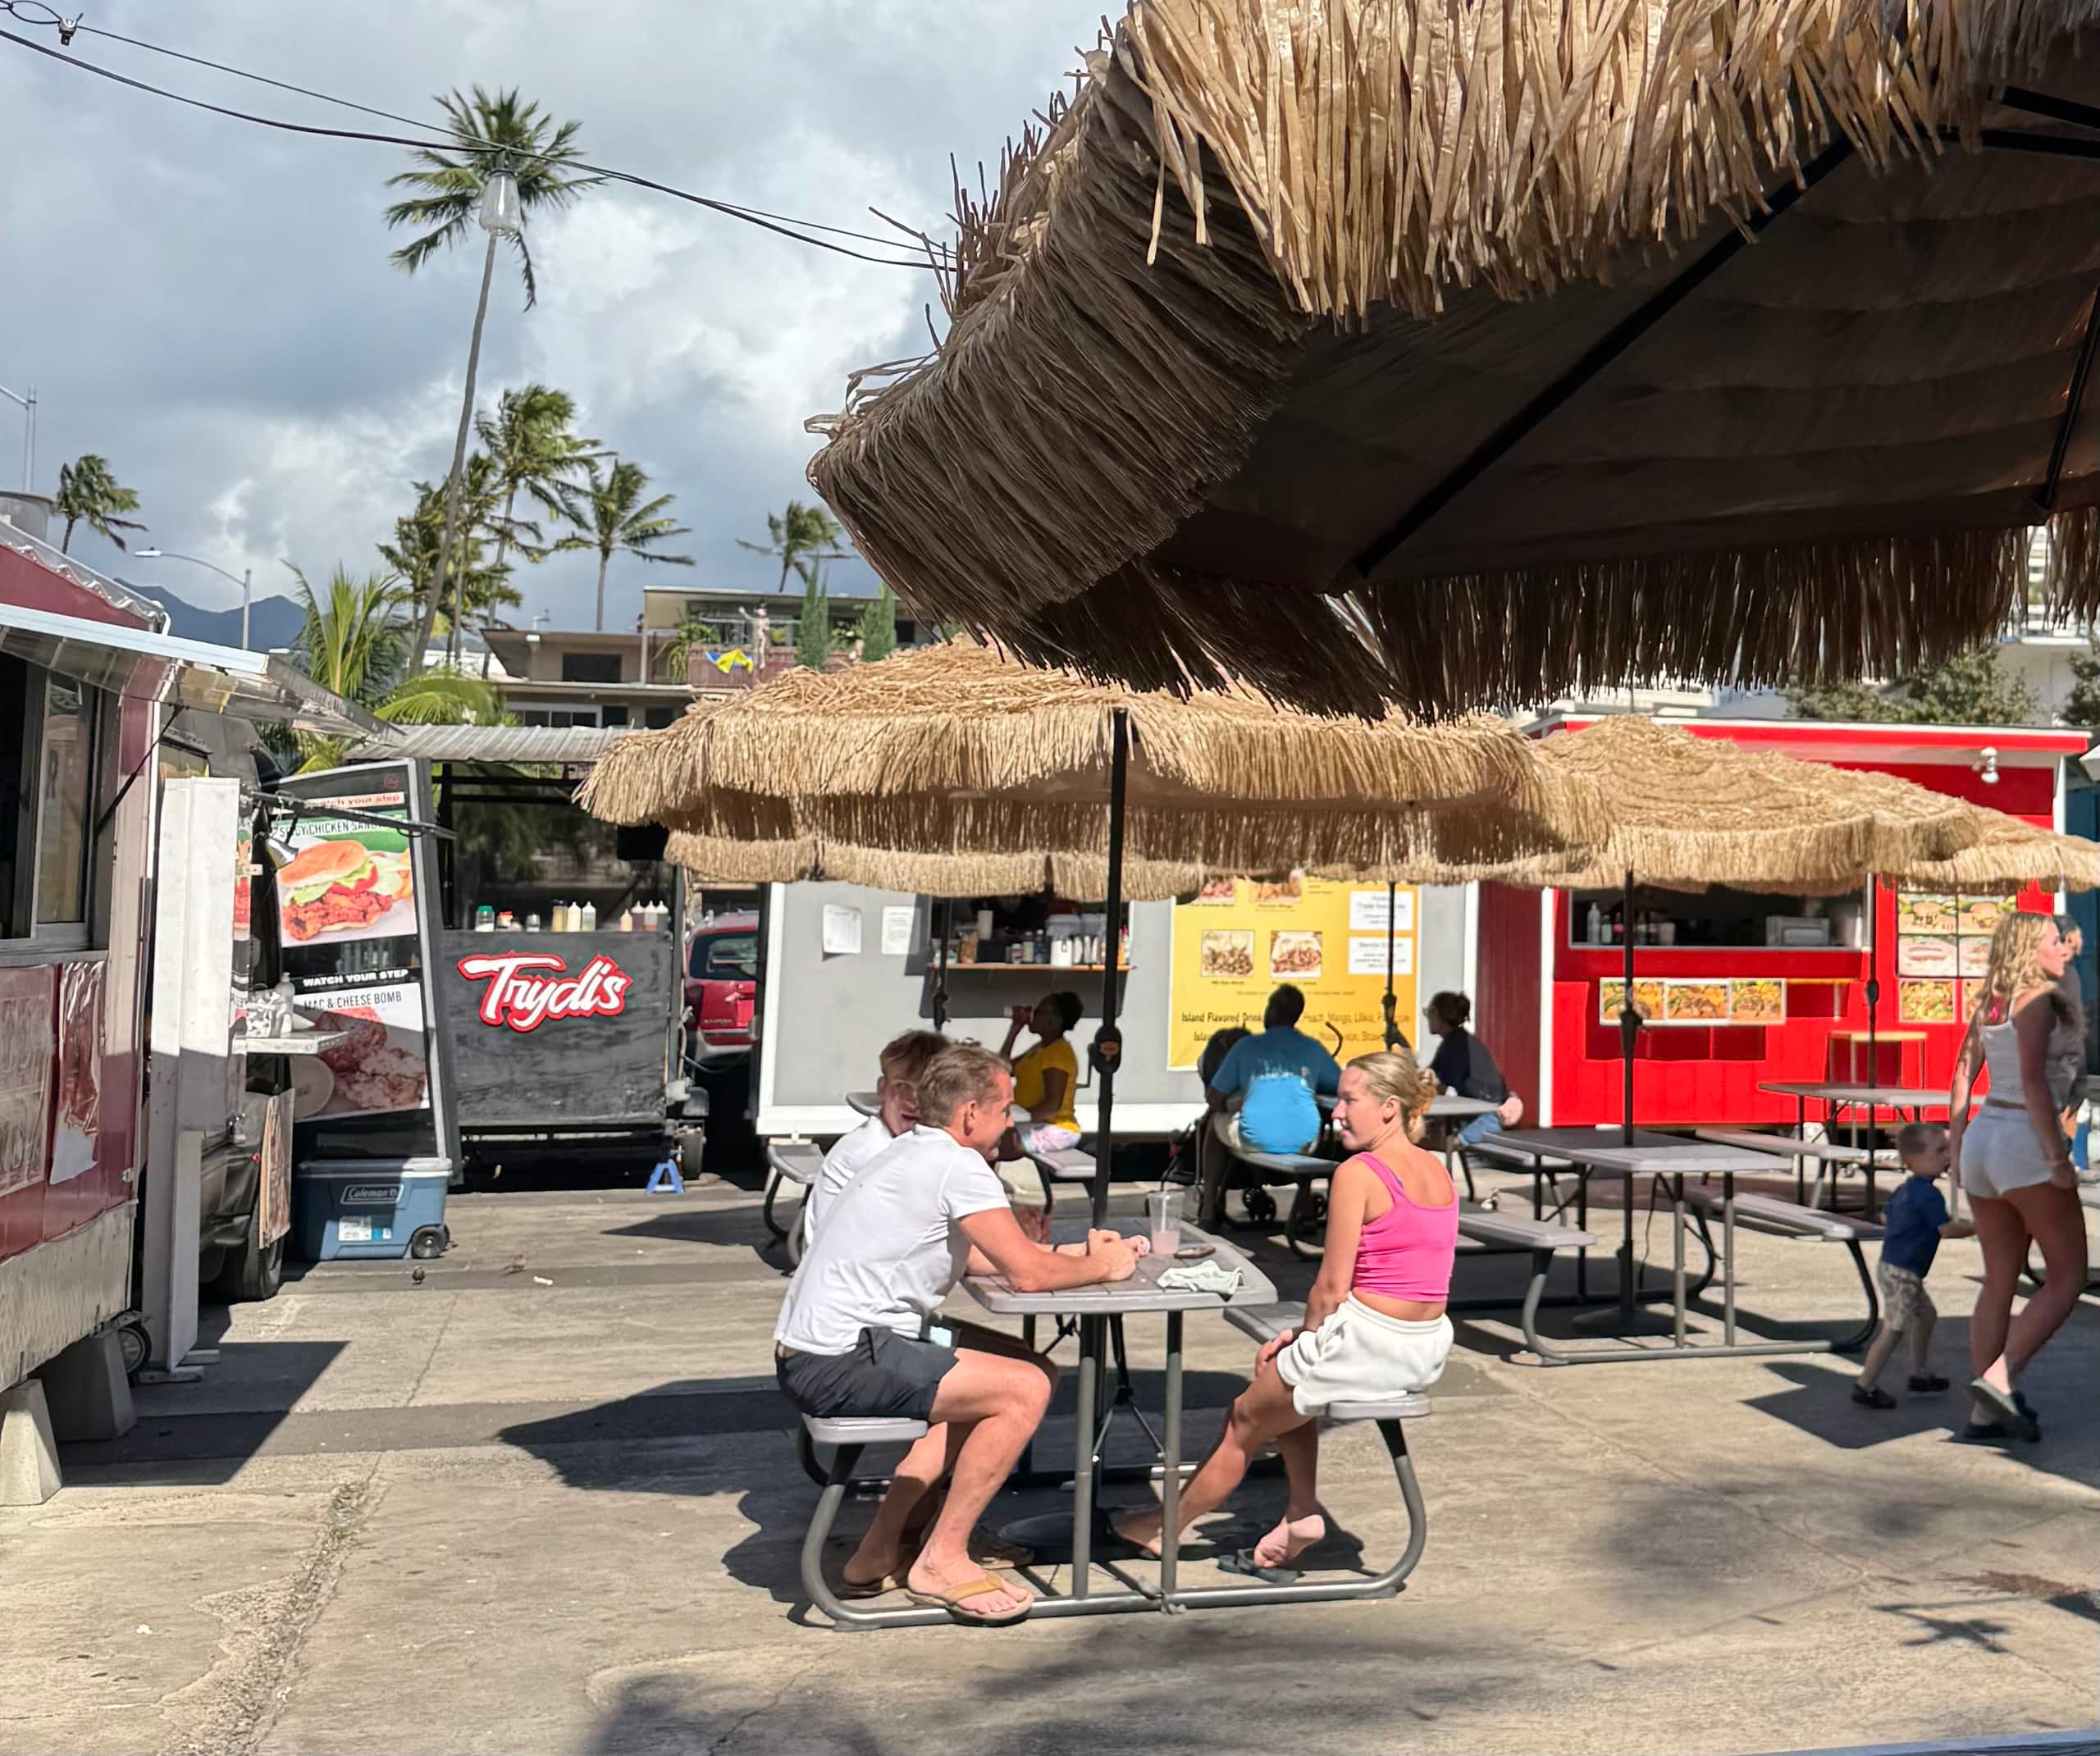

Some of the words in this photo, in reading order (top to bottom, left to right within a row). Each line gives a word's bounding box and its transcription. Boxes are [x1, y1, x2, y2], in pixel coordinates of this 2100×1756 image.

[308, 821, 349, 835] CHICKEN
[303, 975, 343, 987] WATCH
[345, 972, 377, 983] YOUR
[379, 969, 409, 980] STEP
[304, 999, 324, 1010] MAC
[327, 997, 334, 1009] &
[337, 993, 371, 1008] CHEESE
[373, 990, 402, 1004] BOMB
[1181, 1012, 1205, 1022] Island
[1208, 1012, 1239, 1023] Flavored
[349, 1187, 388, 1198] Coleman
